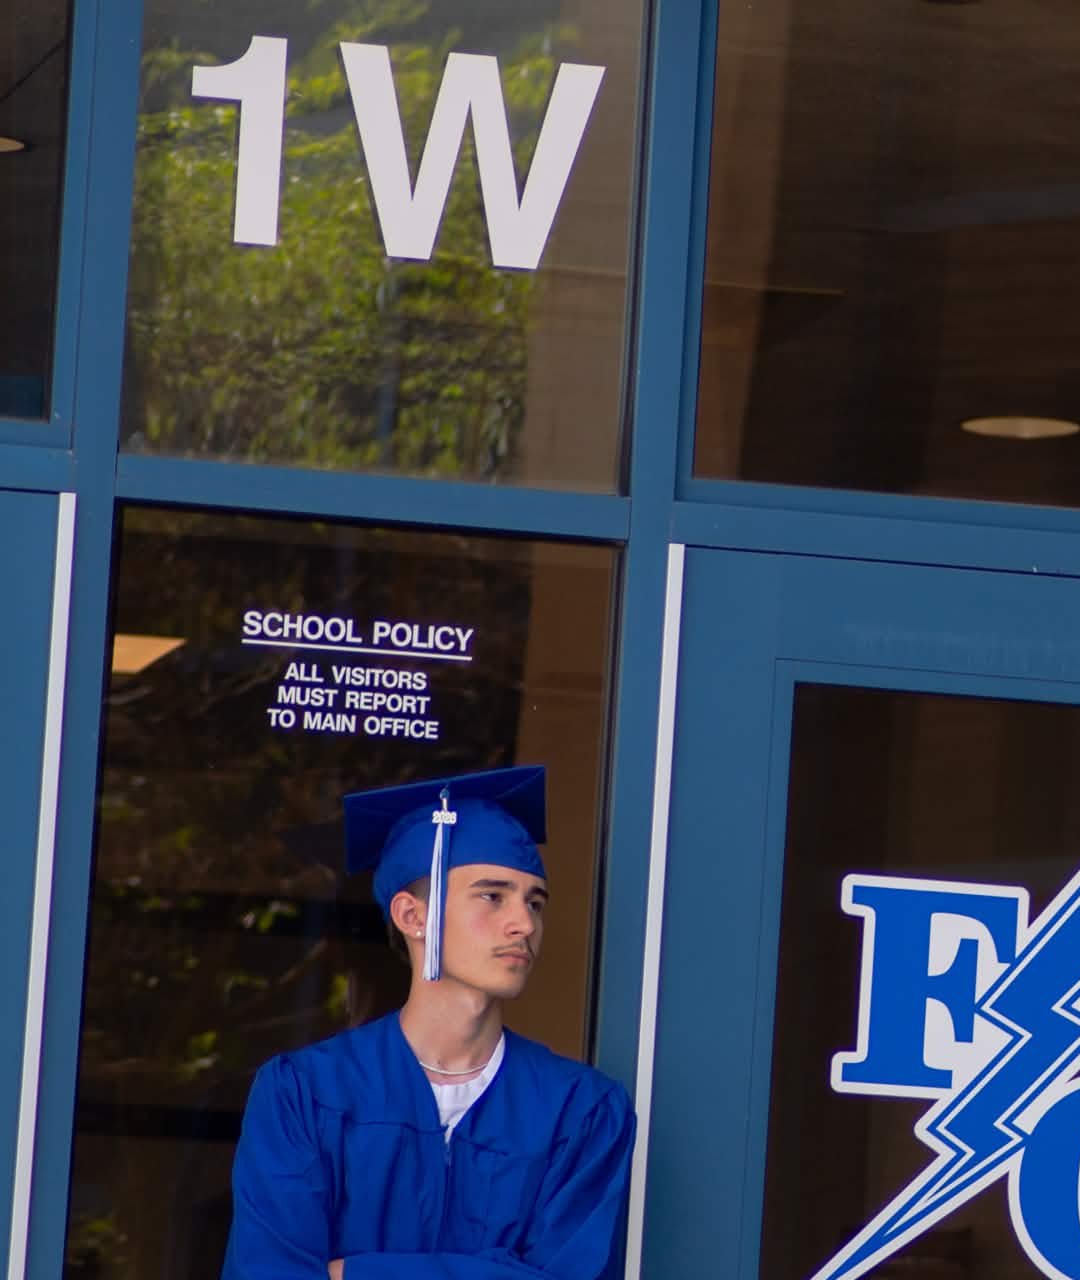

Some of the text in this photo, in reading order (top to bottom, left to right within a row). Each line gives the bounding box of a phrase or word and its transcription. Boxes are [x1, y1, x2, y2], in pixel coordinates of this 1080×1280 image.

[191, 35, 606, 270] 1W
[242, 610, 474, 652] SCHOOL POLICY
[284, 662, 427, 691] ALL VISITORS
[277, 685, 431, 715] MUST REPORT
[266, 708, 439, 739] TO MAIN OFFICE
